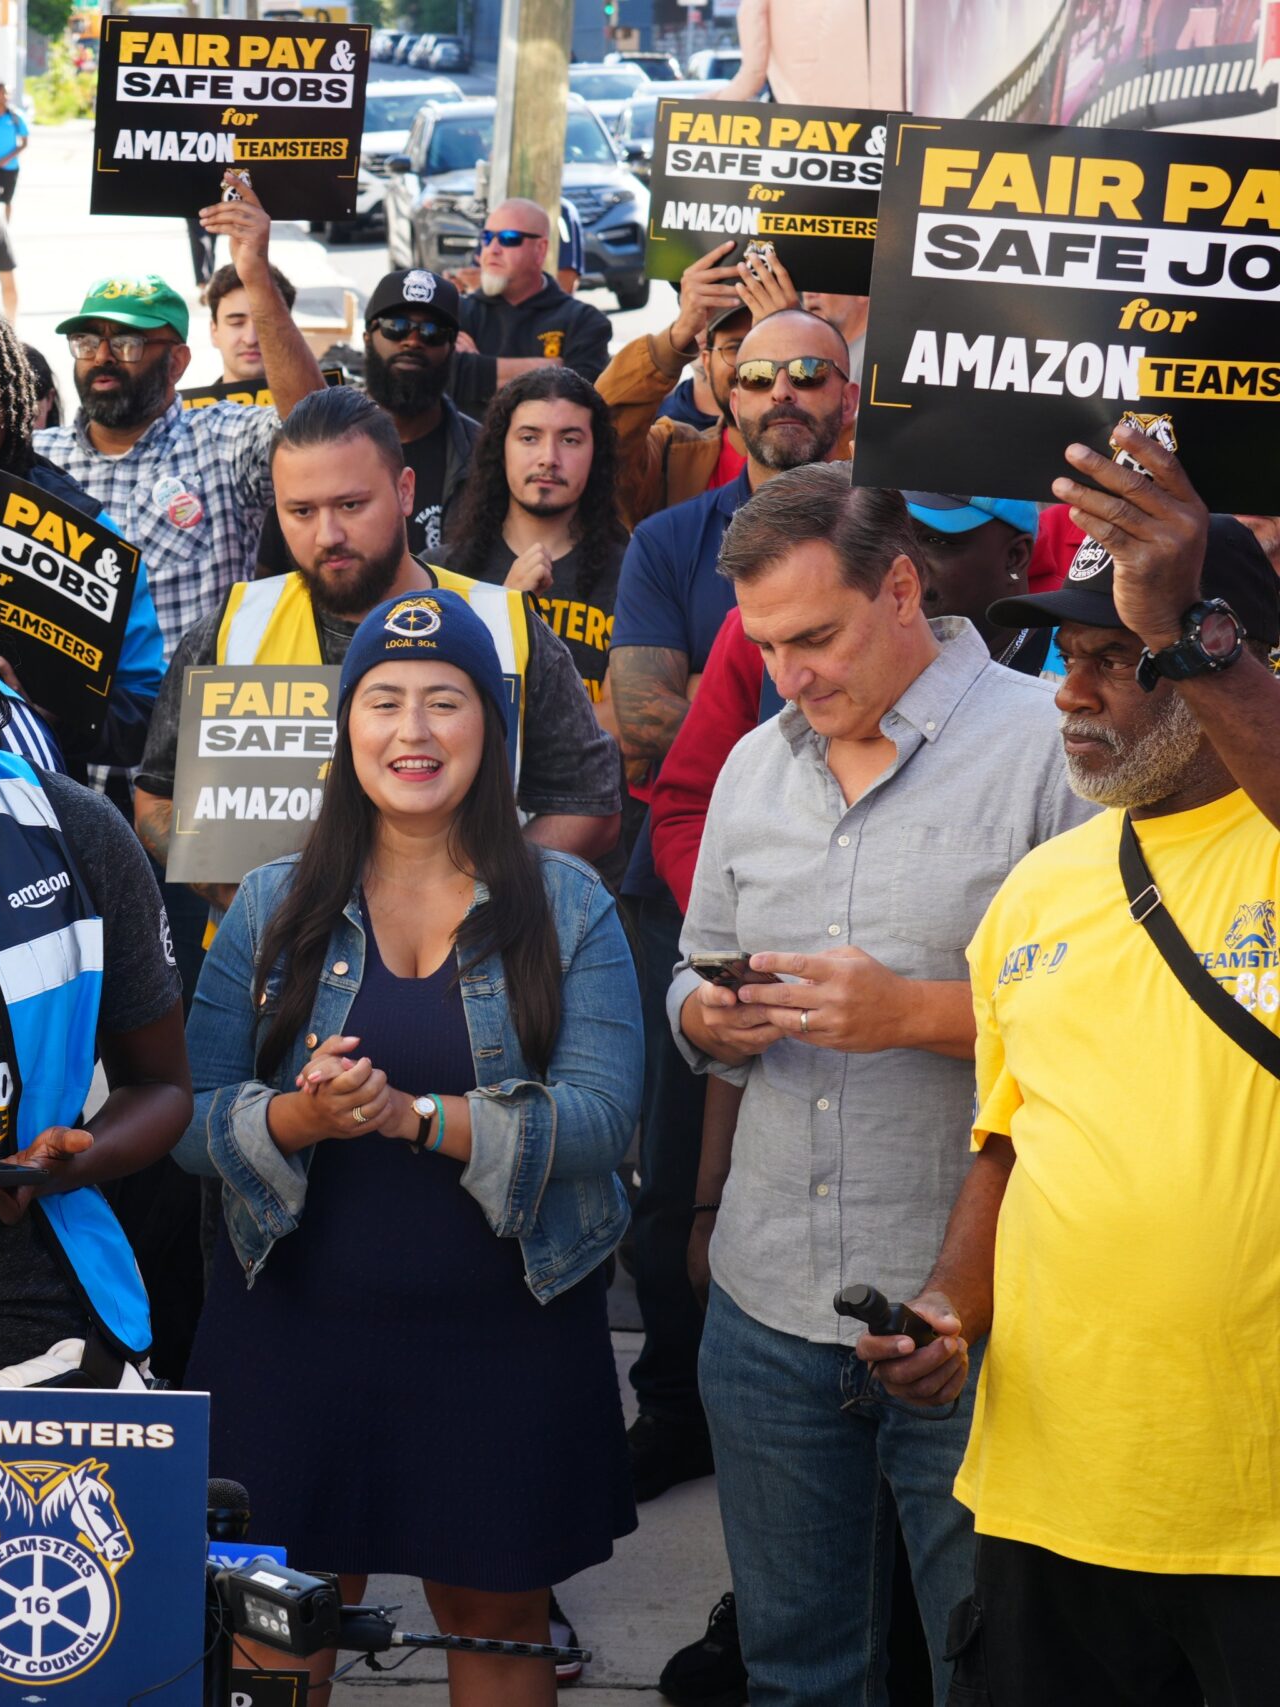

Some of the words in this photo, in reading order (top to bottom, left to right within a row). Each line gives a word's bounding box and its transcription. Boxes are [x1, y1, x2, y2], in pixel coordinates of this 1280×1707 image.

[119, 31, 230, 67] FAIR
[239, 36, 326, 70] PAY
[330, 40, 356, 71] &
[123, 72, 233, 99] SAFE
[243, 77, 347, 103] JOBS
[222, 108, 258, 126] for
[669, 112, 761, 147] FAIR
[769, 118, 861, 153] PAY
[865, 125, 887, 156] &
[113, 129, 236, 163] AMAZON
[238, 141, 343, 157] TEAMSTERS
[671, 149, 762, 176] SAFE
[771, 157, 883, 185] JOBS
[748, 184, 785, 202] for
[920, 148, 1145, 220] FAIR
[1163, 163, 1280, 230] PA
[661, 201, 761, 236] AMAZON
[762, 216, 877, 236] TEAMSTERS
[923, 223, 1149, 283] SAFE
[1167, 243, 1280, 292] JO
[1118, 297, 1197, 334] for
[901, 330, 1146, 400] AMAZON
[1149, 363, 1280, 397] TEAMS
[414, 504, 443, 525] TEAM
[3, 493, 95, 562] PAY
[94, 548, 122, 585] &
[1, 543, 109, 612] JOBS
[385, 639, 415, 649] LOCAL
[417, 640, 437, 648] 804
[202, 681, 329, 717] FAIR
[205, 723, 333, 752] SAFE
[8, 871, 71, 909] amaon
[1195, 950, 1280, 971] TEAMSTE
[1234, 971, 1280, 1013] 86
[21, 1596, 51, 1614] 16
[25, 1630, 101, 1673] COUNCIL
